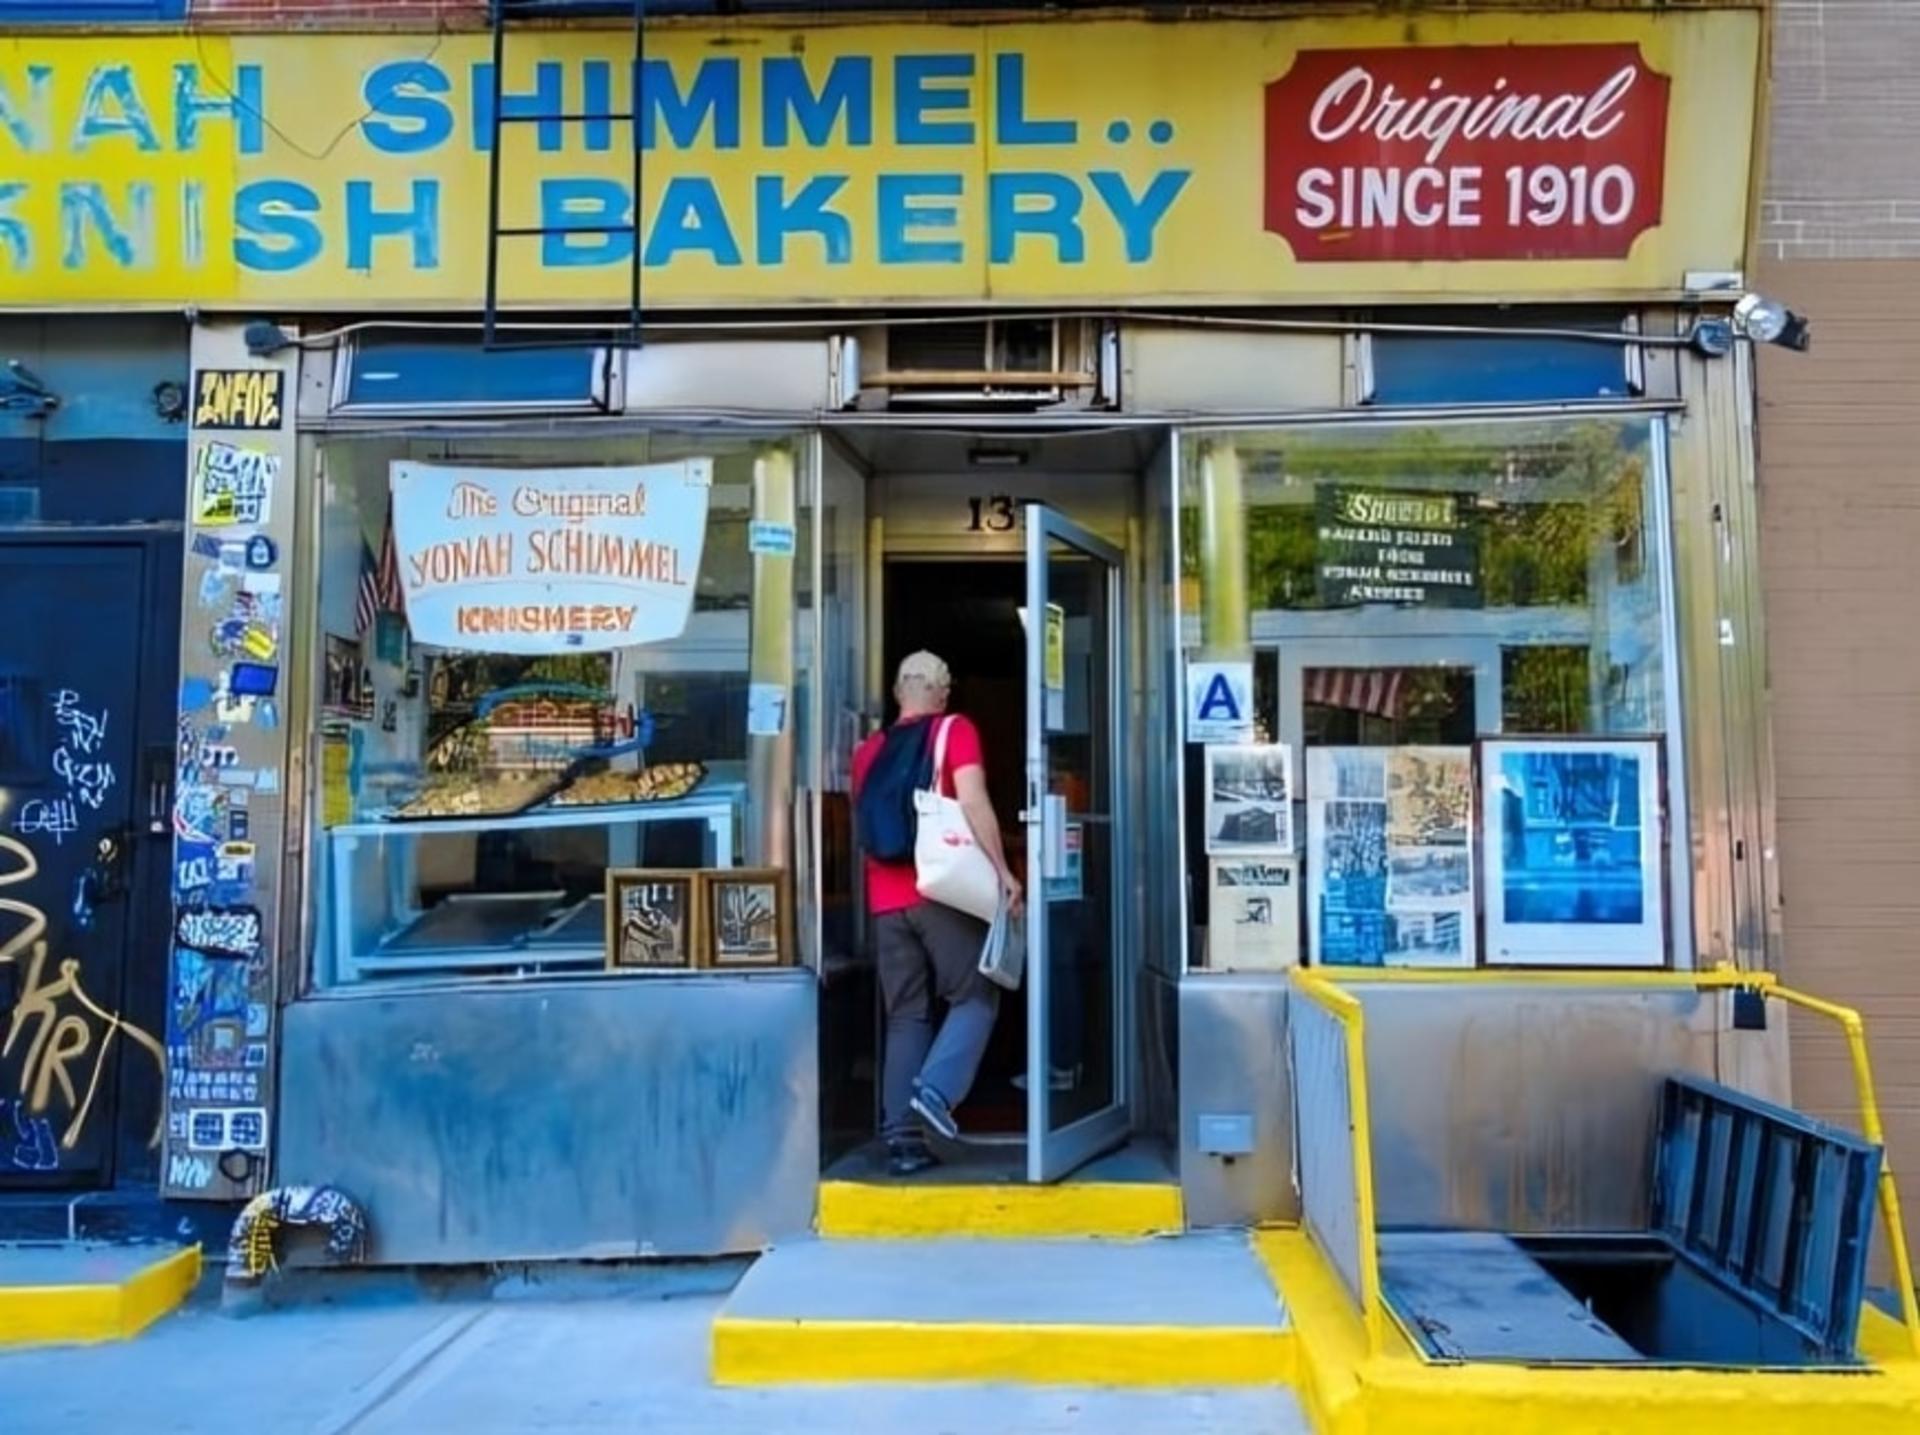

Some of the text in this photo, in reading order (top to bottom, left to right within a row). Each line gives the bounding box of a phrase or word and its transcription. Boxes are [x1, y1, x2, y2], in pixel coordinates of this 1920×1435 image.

[1309, 65, 1637, 164] Original
[541, 170, 1193, 268] BAKERY
[1296, 164, 1635, 228] SINCE 1910
[446, 481, 646, 524] The Original
[410, 532, 512, 587] YONAH
[1198, 663, 1241, 721] A
